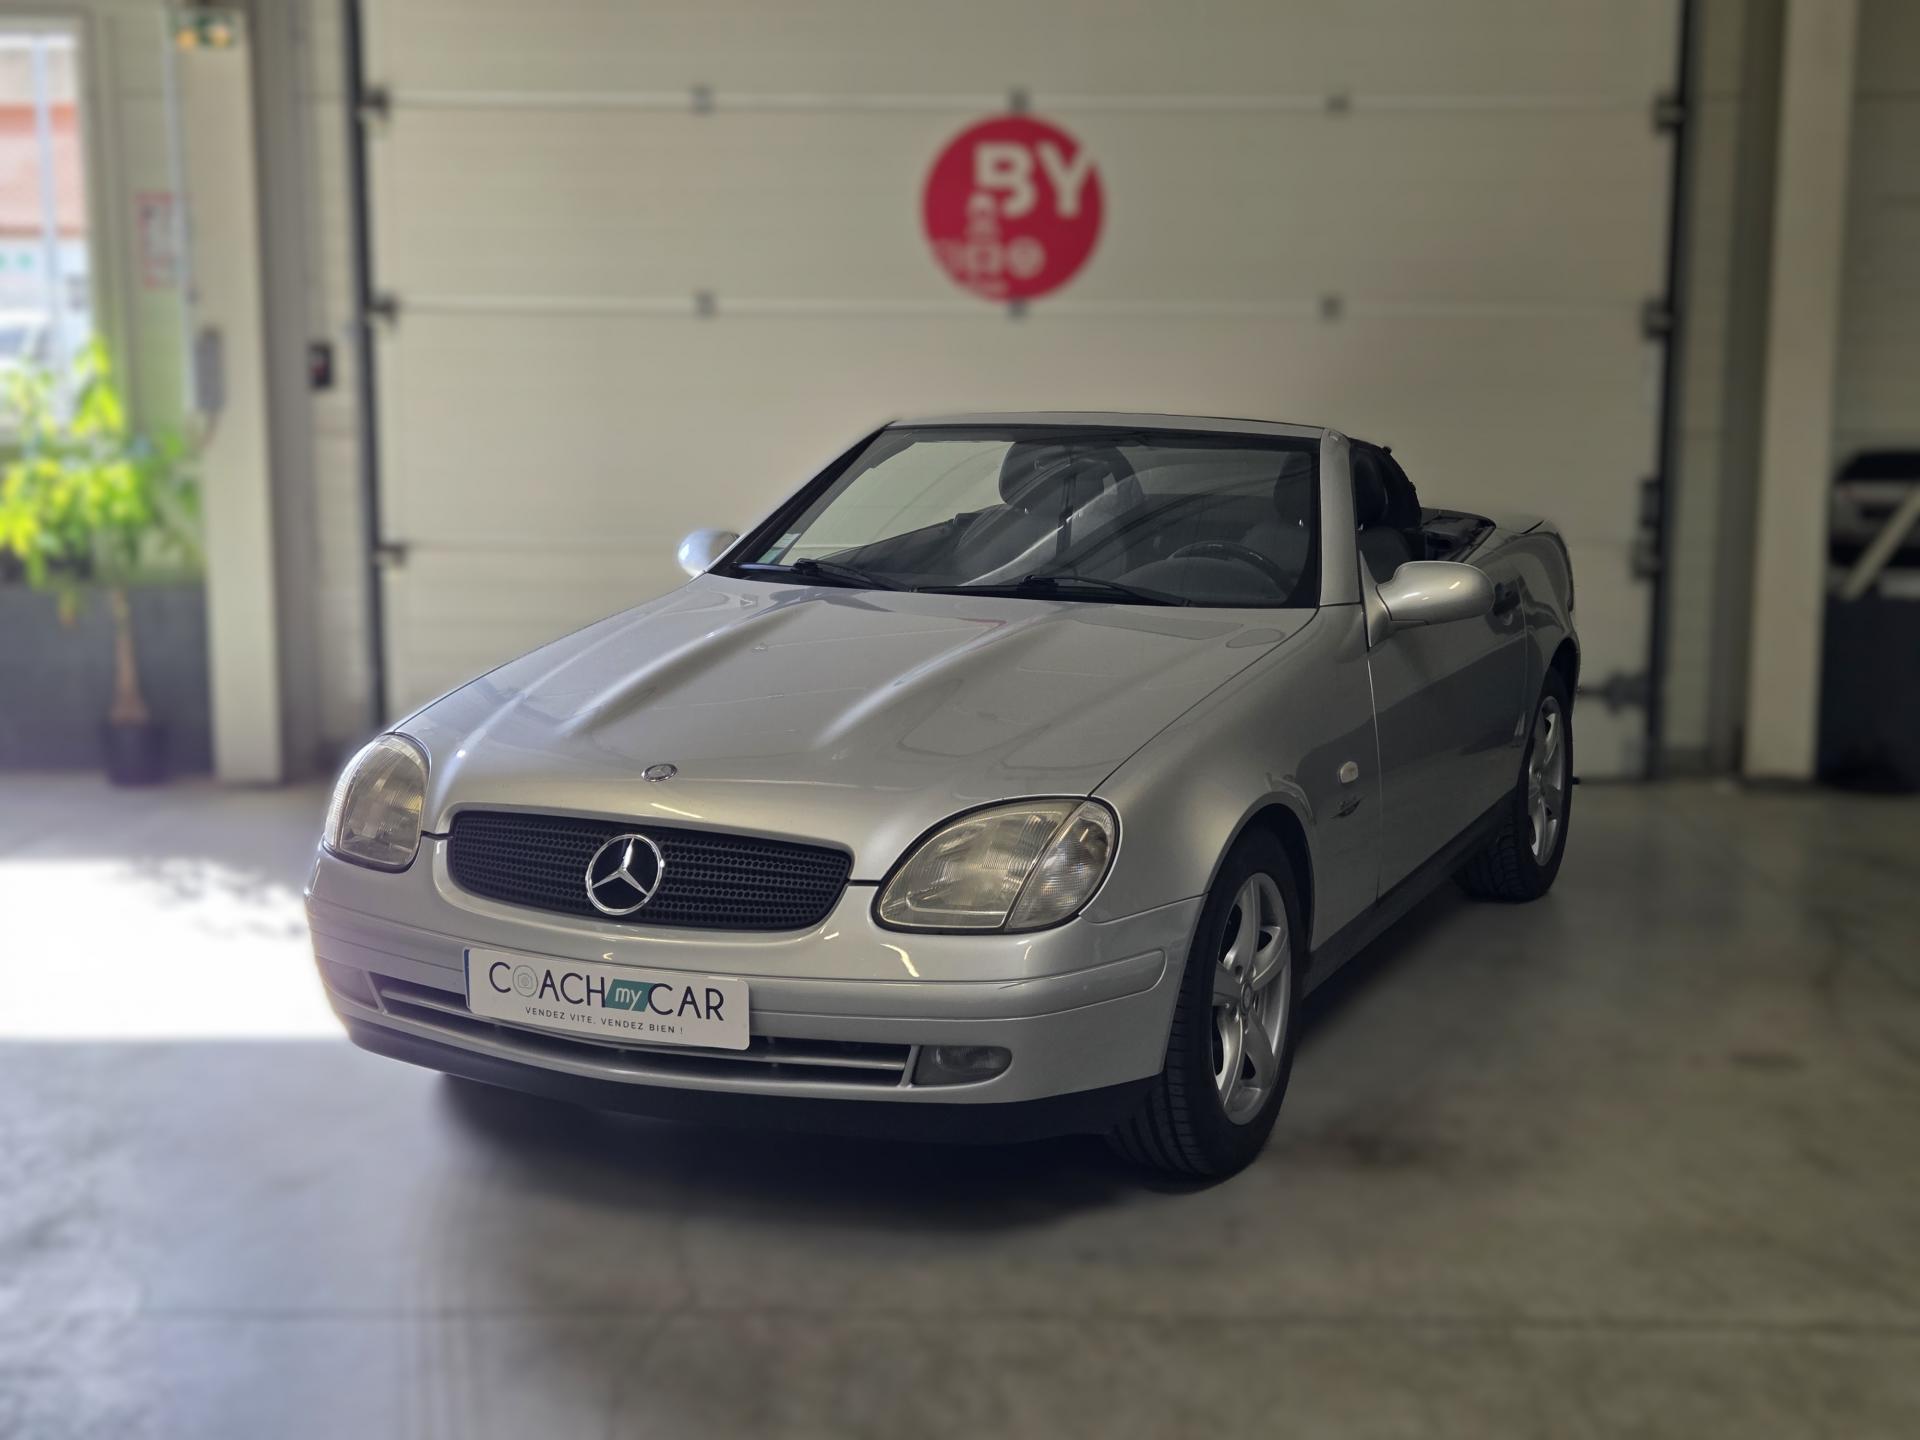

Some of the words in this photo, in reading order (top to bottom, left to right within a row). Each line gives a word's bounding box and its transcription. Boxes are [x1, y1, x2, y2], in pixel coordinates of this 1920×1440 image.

[974, 140, 1098, 219] BY
[525, 1006, 566, 1020] VENDEZ
[600, 1017, 644, 1031] VENDEZ
[649, 1023, 675, 1034] BIEN
